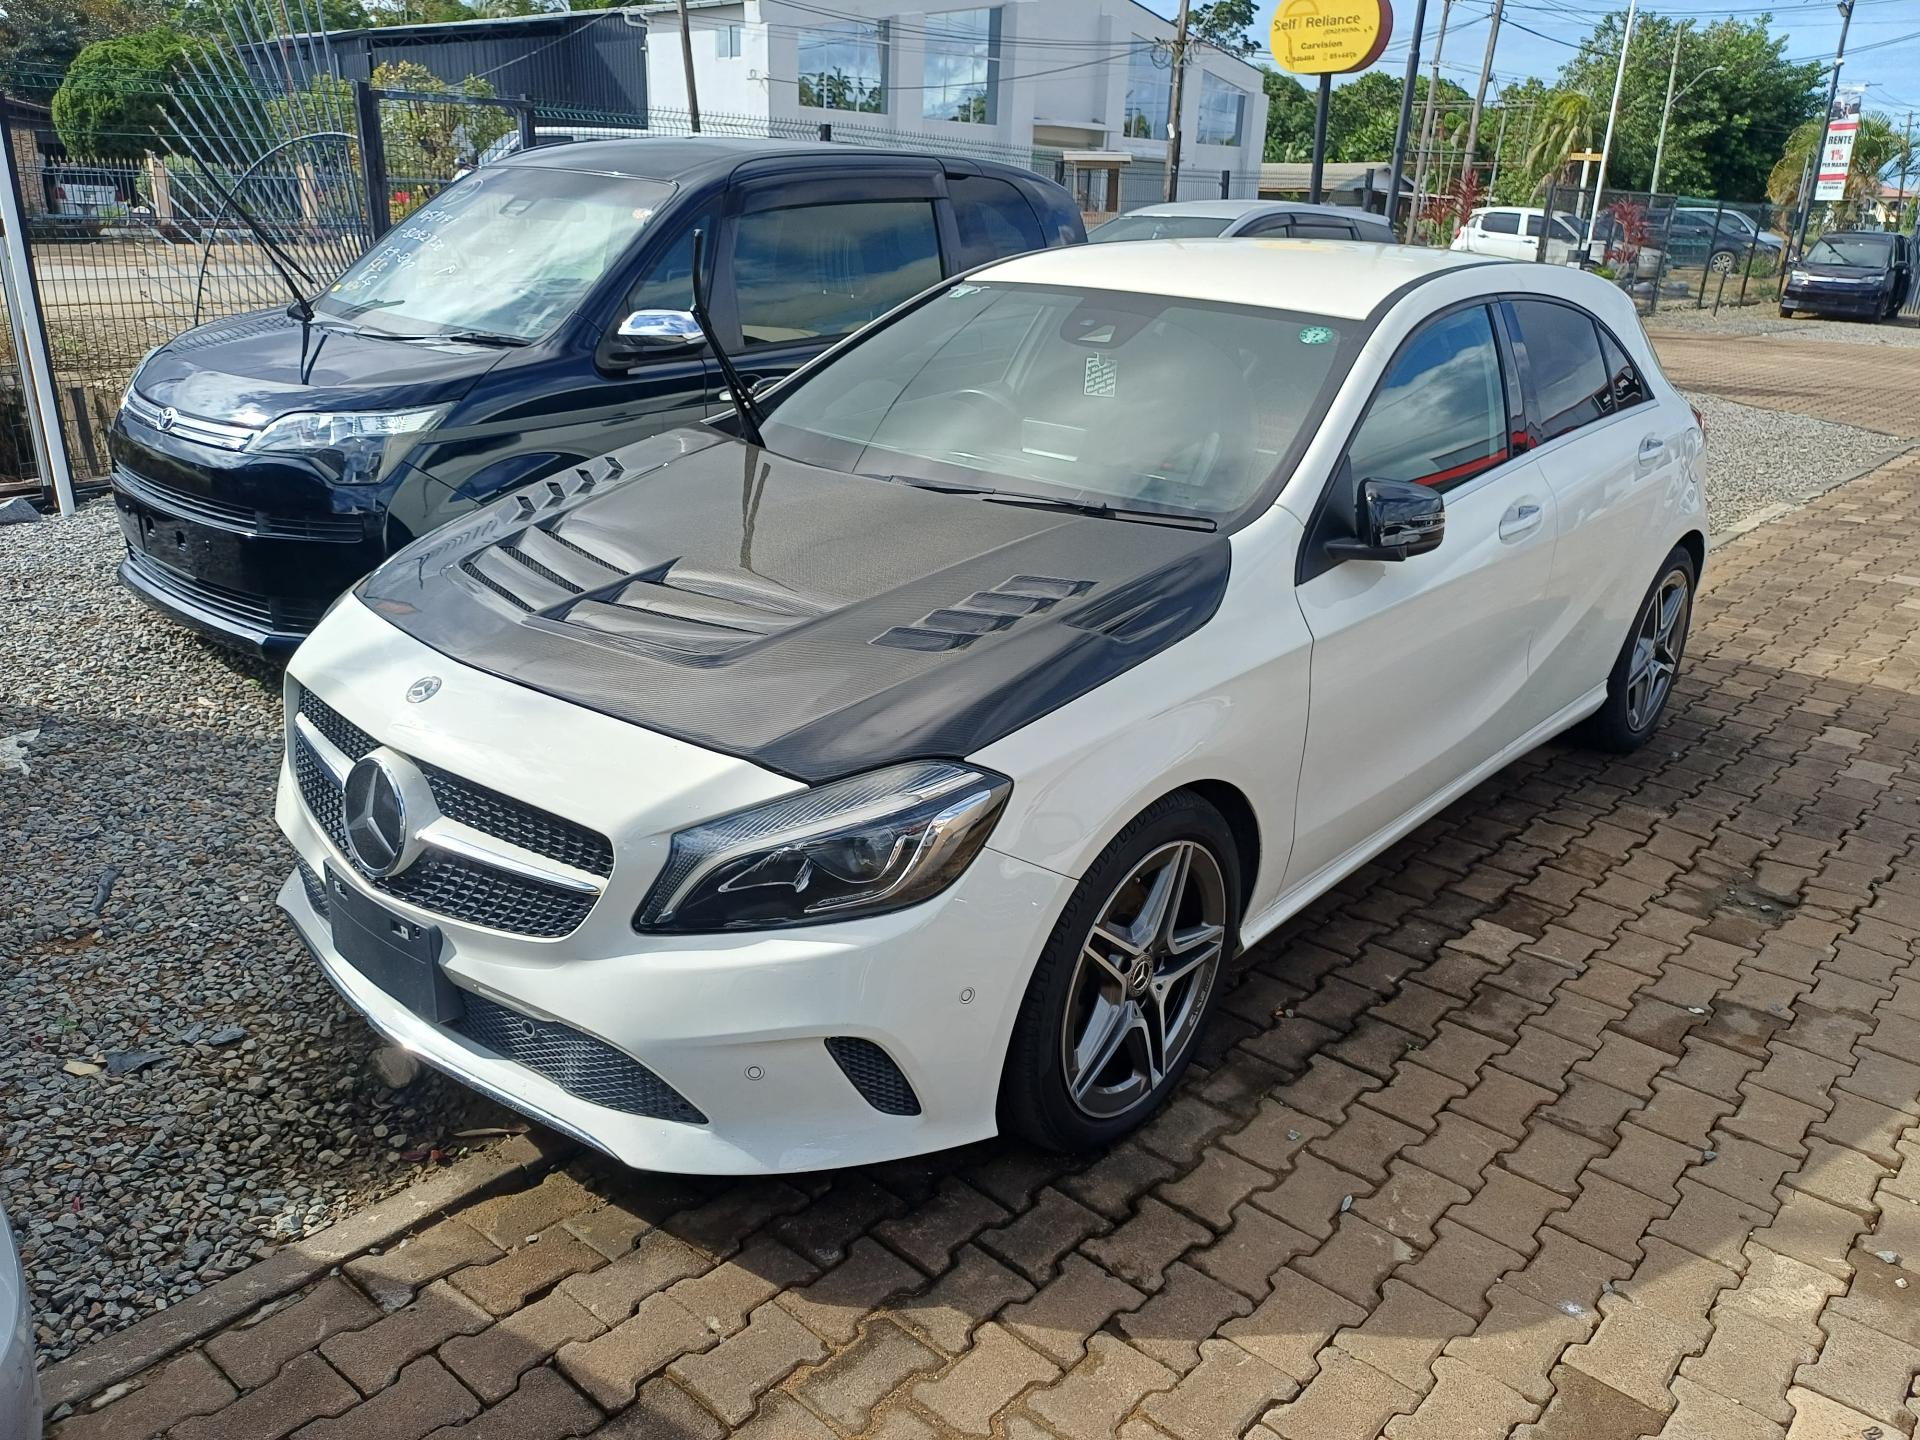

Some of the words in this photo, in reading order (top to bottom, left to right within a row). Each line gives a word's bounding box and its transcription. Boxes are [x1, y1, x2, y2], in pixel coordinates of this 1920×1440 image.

[1274, 19, 1297, 31] Self
[1305, 14, 1361, 28] Reliance
[1301, 40, 1342, 49] Carvision
[1828, 135, 1852, 144] RENTE
